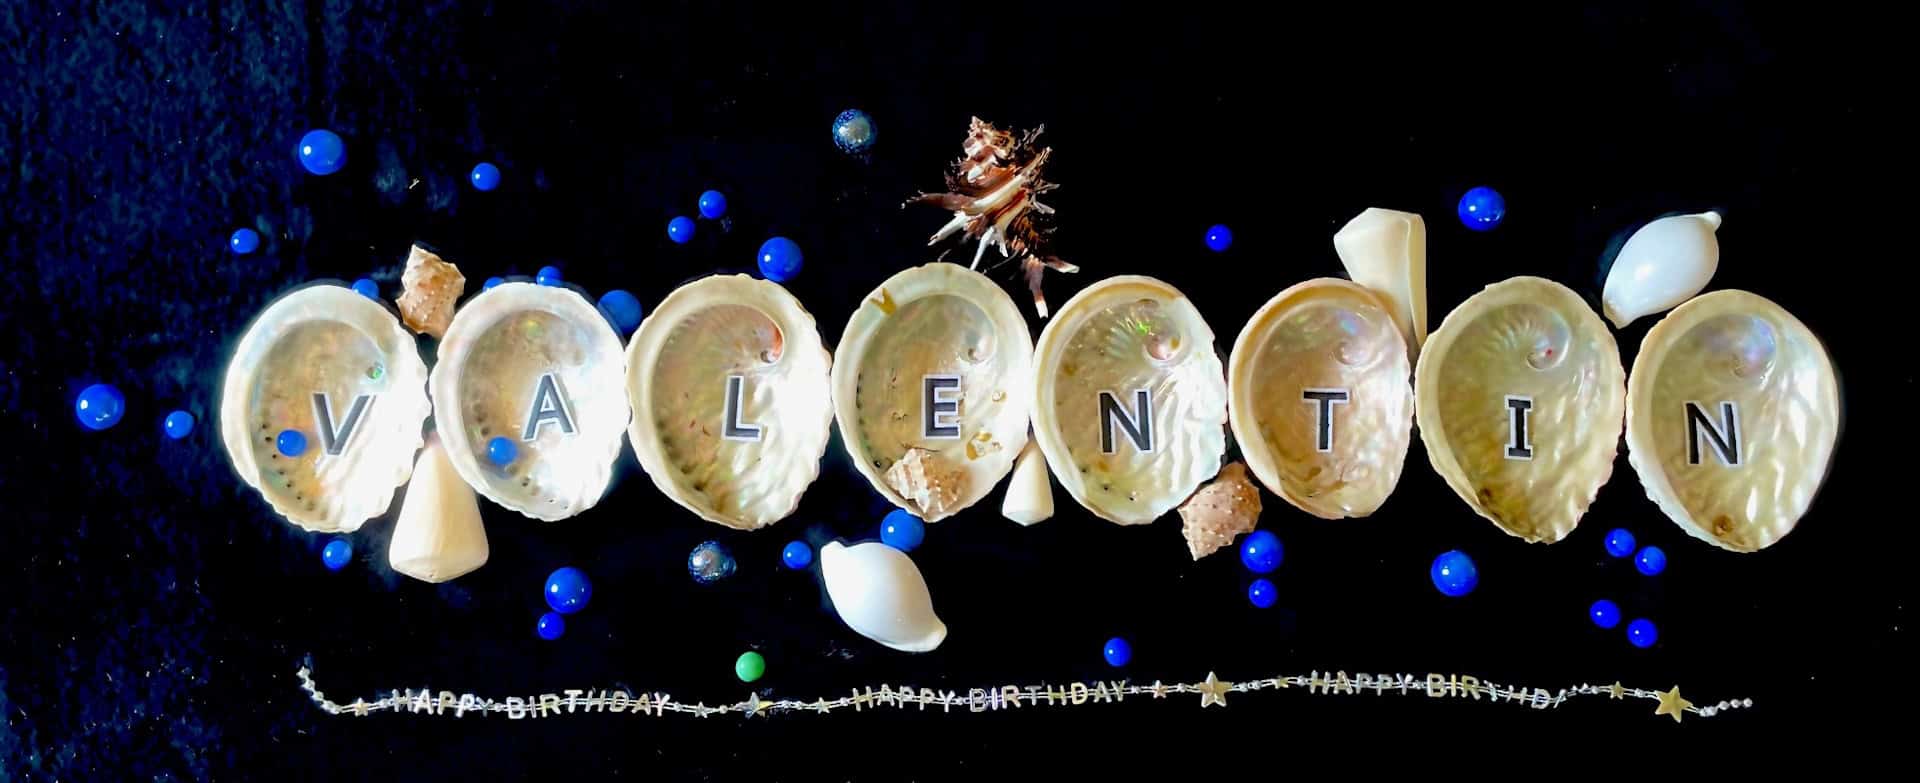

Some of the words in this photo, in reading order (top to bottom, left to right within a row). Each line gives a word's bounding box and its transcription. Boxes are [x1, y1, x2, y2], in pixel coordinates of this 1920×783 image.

[392, 688, 494, 718] HAPPY
[507, 689, 671, 720] BIRTHDAY
[850, 683, 957, 713] HAPPY
[968, 680, 1127, 713] BIRTHDAY
[1308, 669, 1413, 695] HAPPY
